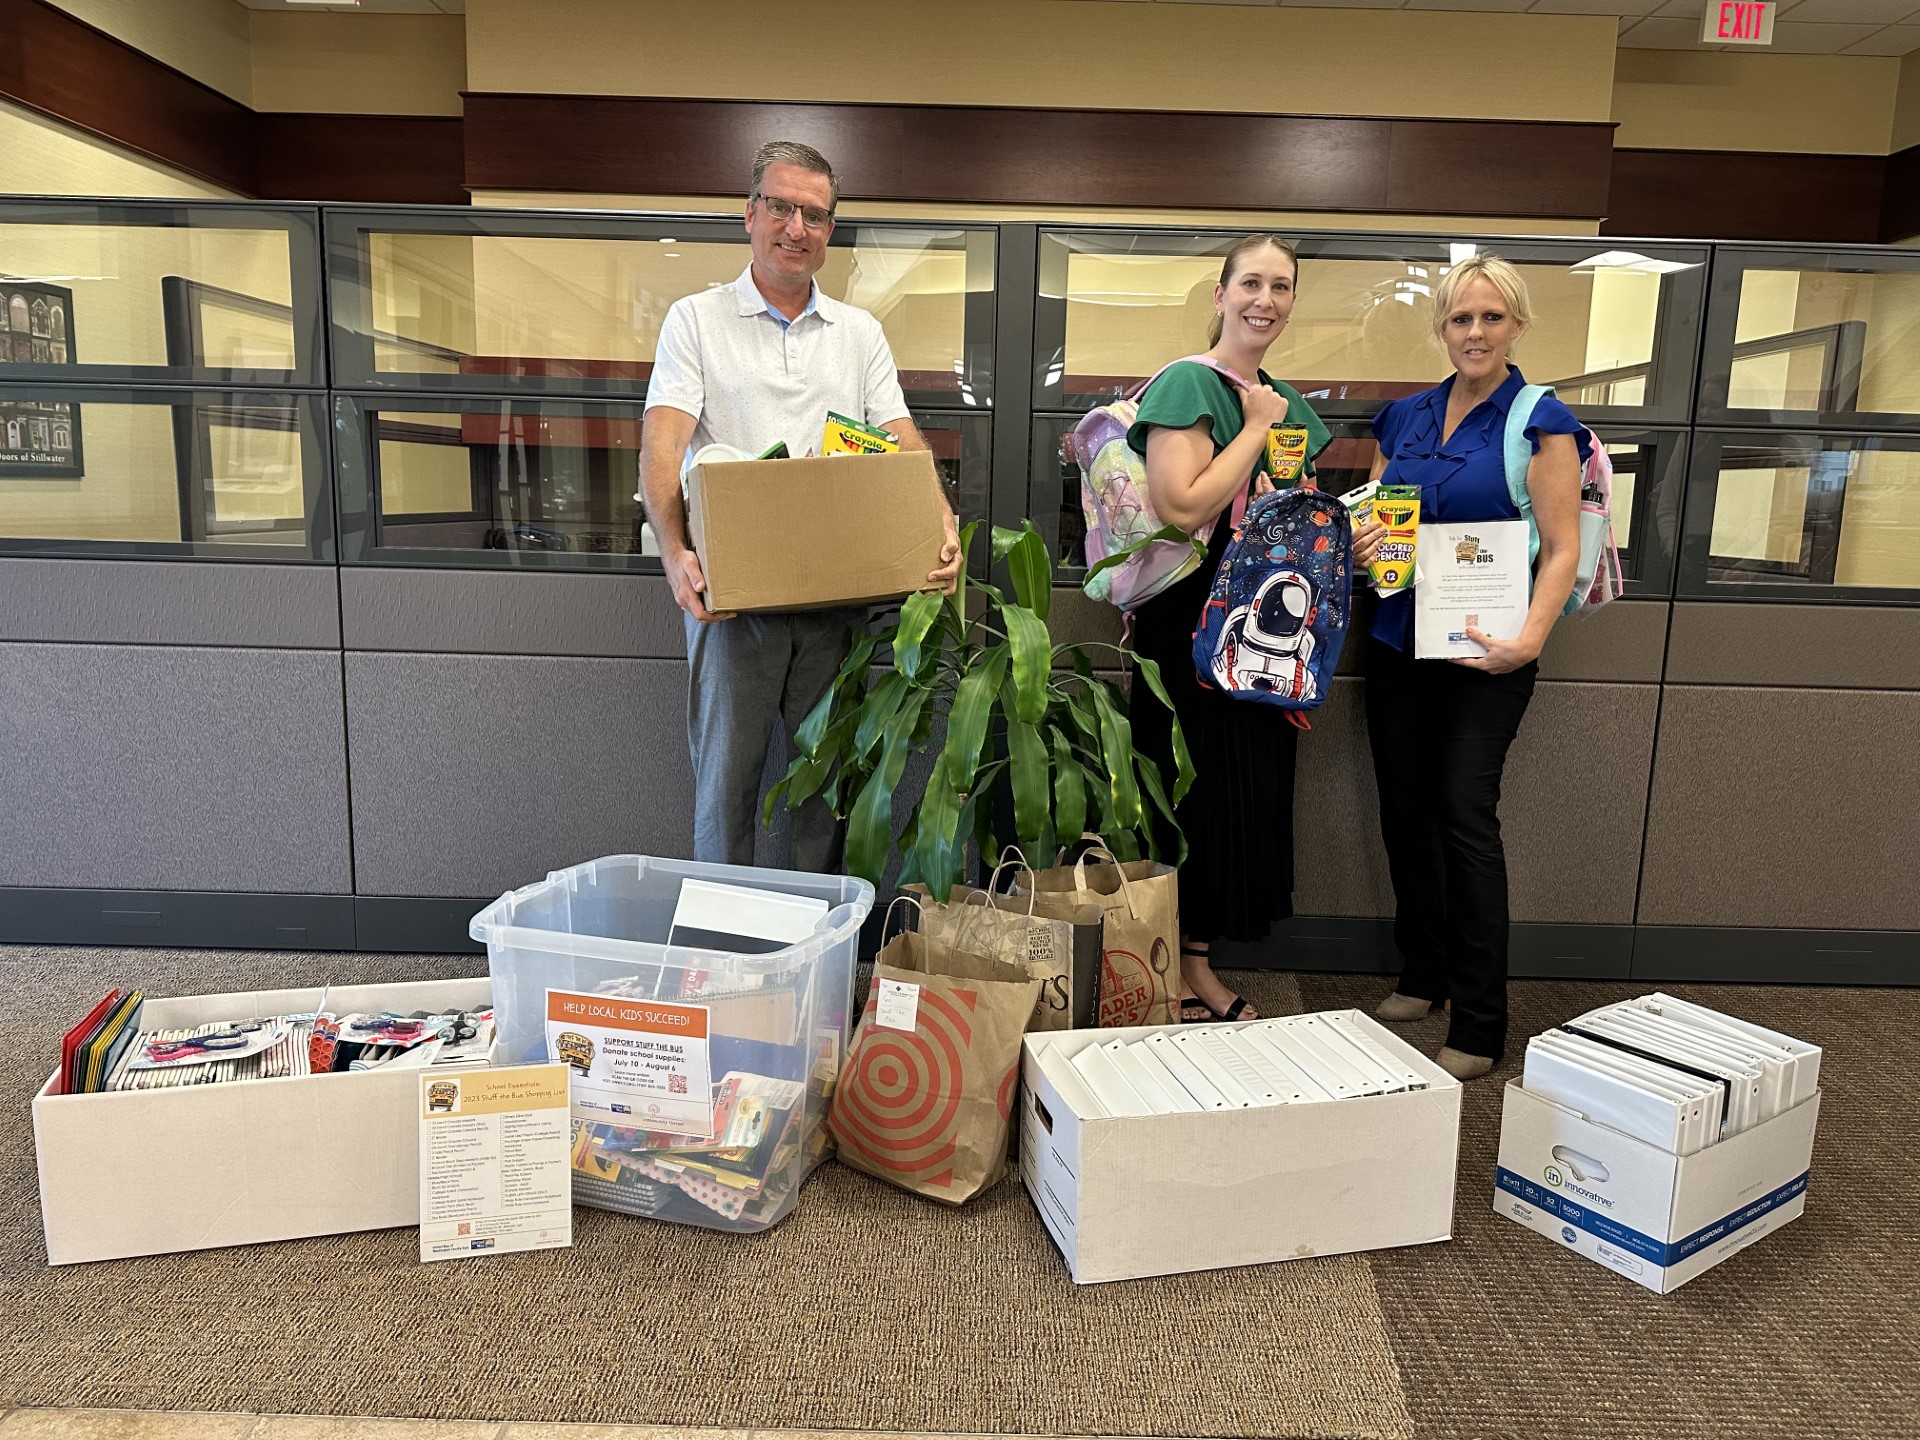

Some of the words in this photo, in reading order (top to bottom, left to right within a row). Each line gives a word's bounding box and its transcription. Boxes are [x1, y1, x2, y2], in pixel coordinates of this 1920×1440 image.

[1718, 2, 1766, 39] EXIT
[827, 416, 837, 424] 10
[843, 430, 883, 450] Crayola
[1278, 432, 1303, 440] Crayola
[20, 452, 29, 461] of
[30, 452, 65, 462] Stillwater
[1272, 459, 1300, 467] CRAYONS
[1379, 491, 1388, 499] 12
[1381, 505, 1411, 513] Crayola
[1464, 534, 1480, 544] Stuff
[1378, 543, 1415, 553] OLORED
[1375, 551, 1412, 563] PENCILS
[1476, 554, 1494, 563] BUS
[1386, 573, 1396, 581] 12
[1029, 948, 1053, 956] 100%
[563, 1002, 586, 1014] HELP
[588, 1004, 617, 1019] LOCAL
[620, 1009, 644, 1022] KIDS
[645, 1012, 690, 1026] SUCCEED!
[604, 1037, 634, 1047] SUPPORT
[636, 1041, 654, 1049] STUFF
[656, 1043, 668, 1051] THE
[670, 1045, 684, 1053] BUS
[602, 1047, 629, 1056] Donate
[630, 1050, 654, 1059] school
[655, 1054, 686, 1063] supplies:
[614, 1059, 628, 1067] July
[645, 1062, 670, 1071] August
[508, 1081, 540, 1089] Essentials
[482, 1093, 498, 1101] Stuff
[525, 1090, 552, 1098] Shopping
[1548, 1169, 1559, 1184] in
[1525, 1186, 1534, 1194] 20
[1562, 1204, 1580, 1217] 5000
[1680, 1238, 1699, 1253] EXPECT
[1700, 1224, 1724, 1243] RESPONSE
[1729, 1212, 1746, 1227] EXPECT
[1746, 1200, 1772, 1217] REDUCTION
[1776, 1188, 1792, 1201] EXPECT
[1791, 1180, 1805, 1192] RELIEF
